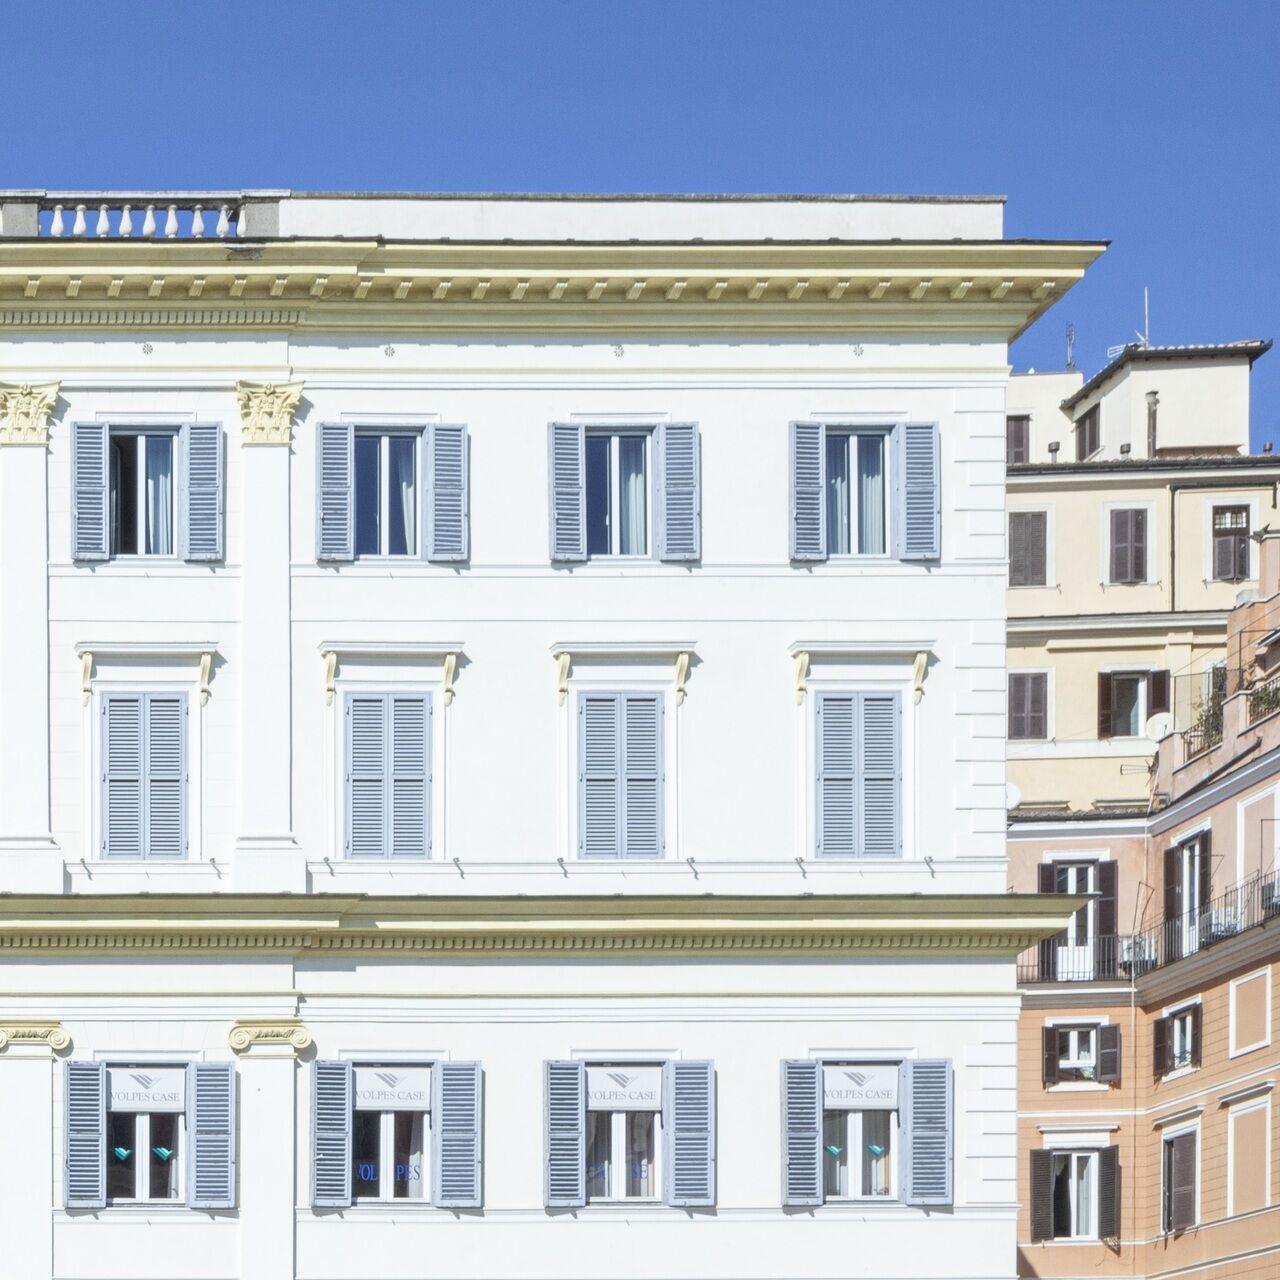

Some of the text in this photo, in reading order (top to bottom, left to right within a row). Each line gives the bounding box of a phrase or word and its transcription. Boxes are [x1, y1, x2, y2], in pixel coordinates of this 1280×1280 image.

[110, 1091, 180, 1102] VOLPES CASE
[356, 1090, 425, 1101] VOLPES CASE
[587, 1090, 657, 1101] VOLPES CASE
[824, 1089, 893, 1099] VOLPES CASE
